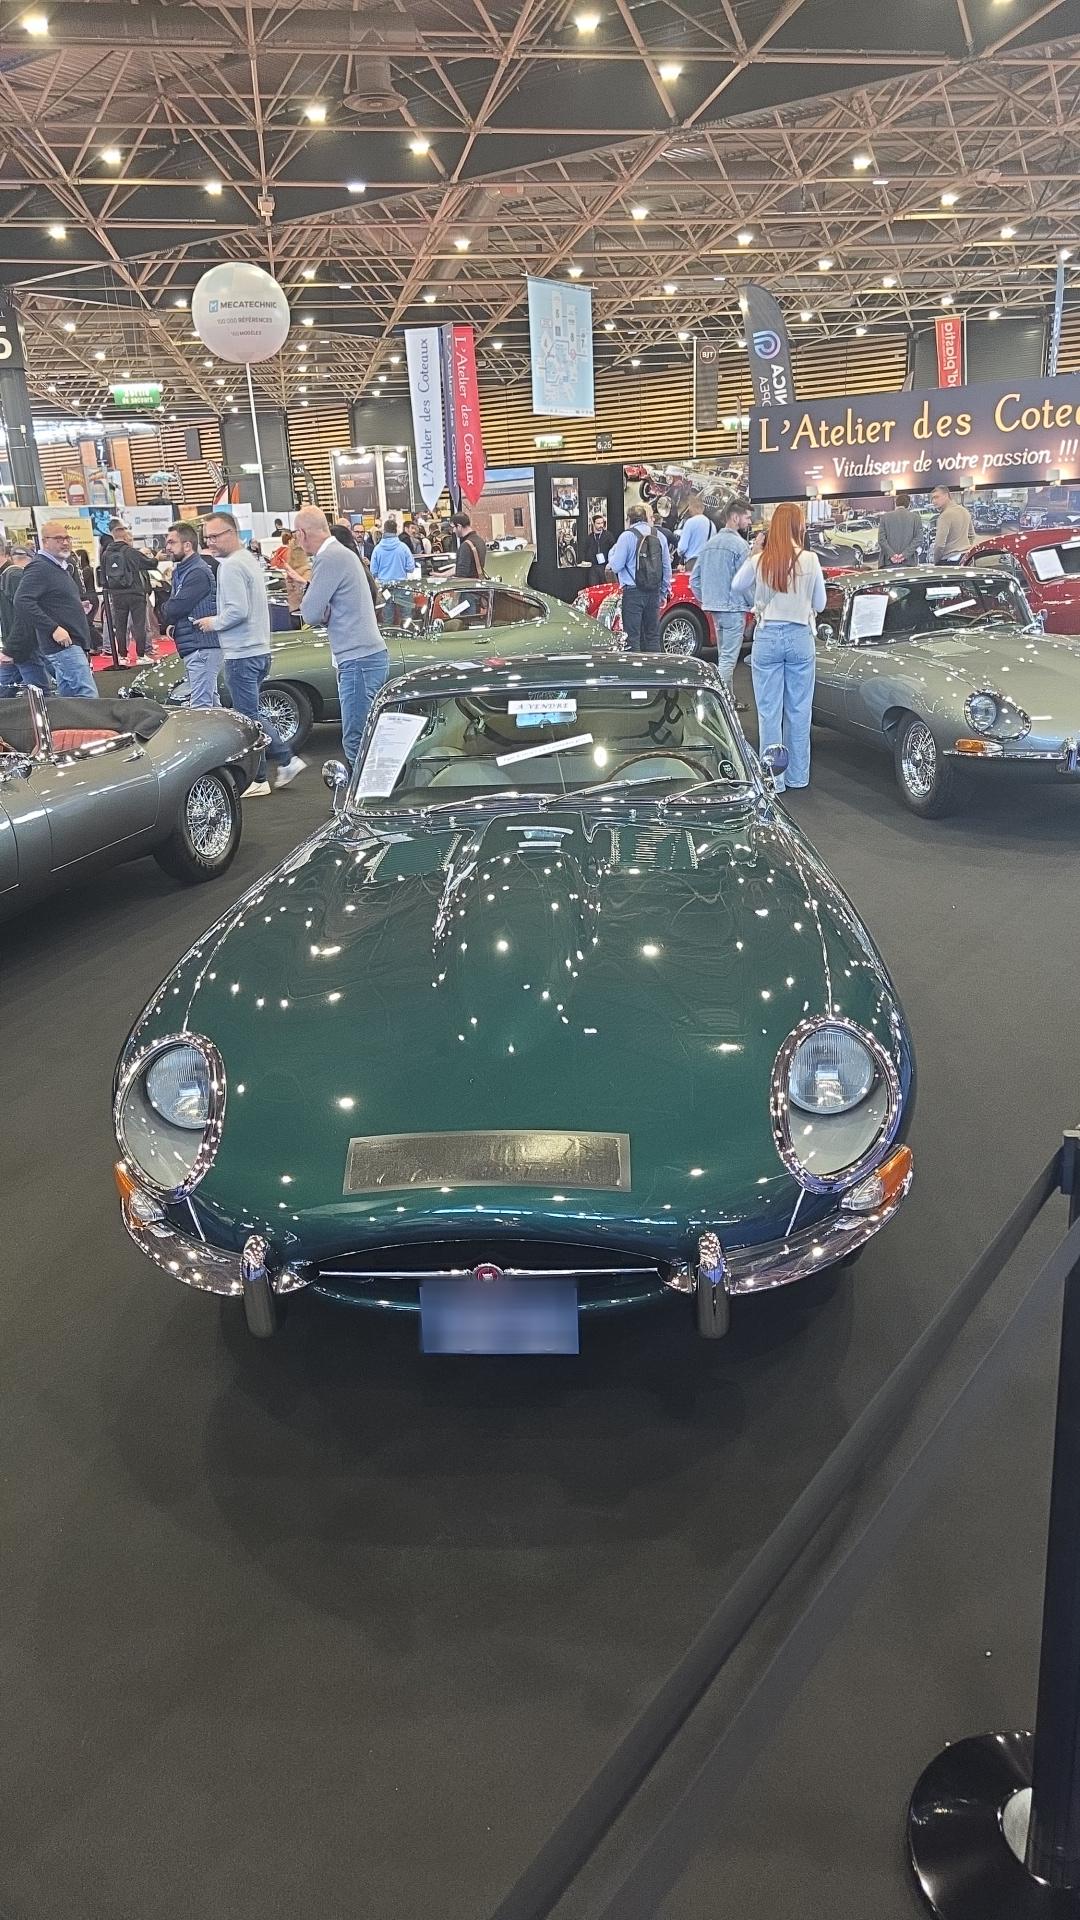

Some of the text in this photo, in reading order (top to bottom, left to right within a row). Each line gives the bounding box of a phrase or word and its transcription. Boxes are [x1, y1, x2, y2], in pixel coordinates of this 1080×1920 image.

[220, 300, 277, 309] MECATECHNIC
[418, 338, 434, 487] L'Atelier des Coteaux
[455, 336, 474, 486] L'Atelier des Coteaux
[758, 407, 896, 453] L'Atelier
[912, 400, 972, 440] des
[597, 441, 611, 450] 6.26
[832, 439, 1079, 478] Vitaliseur de votre passion !!!
[528, 702, 569, 710] VENDRE
